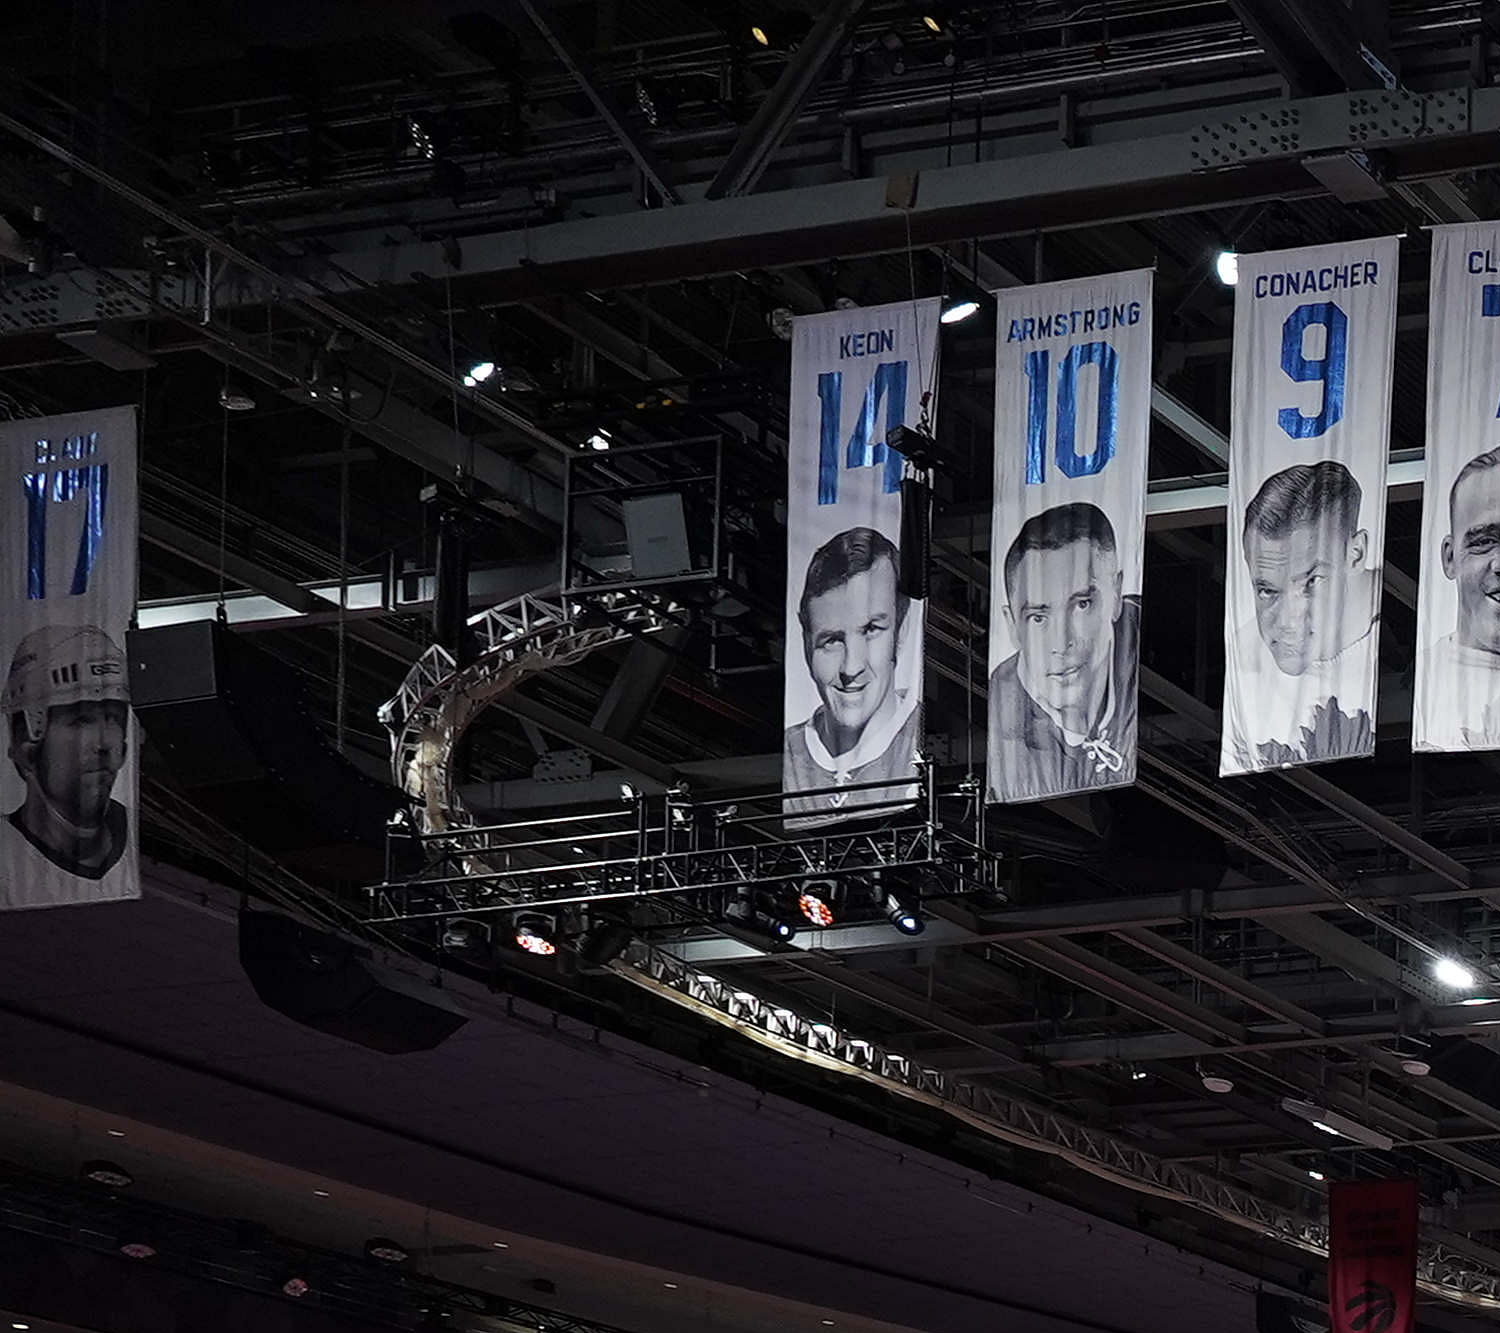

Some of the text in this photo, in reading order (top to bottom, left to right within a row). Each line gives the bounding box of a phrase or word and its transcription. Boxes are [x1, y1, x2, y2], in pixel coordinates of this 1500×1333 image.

[839, 328, 895, 360] KEON
[1006, 301, 1142, 344] ARMSTRONG
[1255, 261, 1379, 299] CONACHER
[817, 360, 908, 506] 14
[1023, 341, 1120, 486] 10
[1277, 301, 1348, 440] 9
[22, 463, 109, 600] 17
